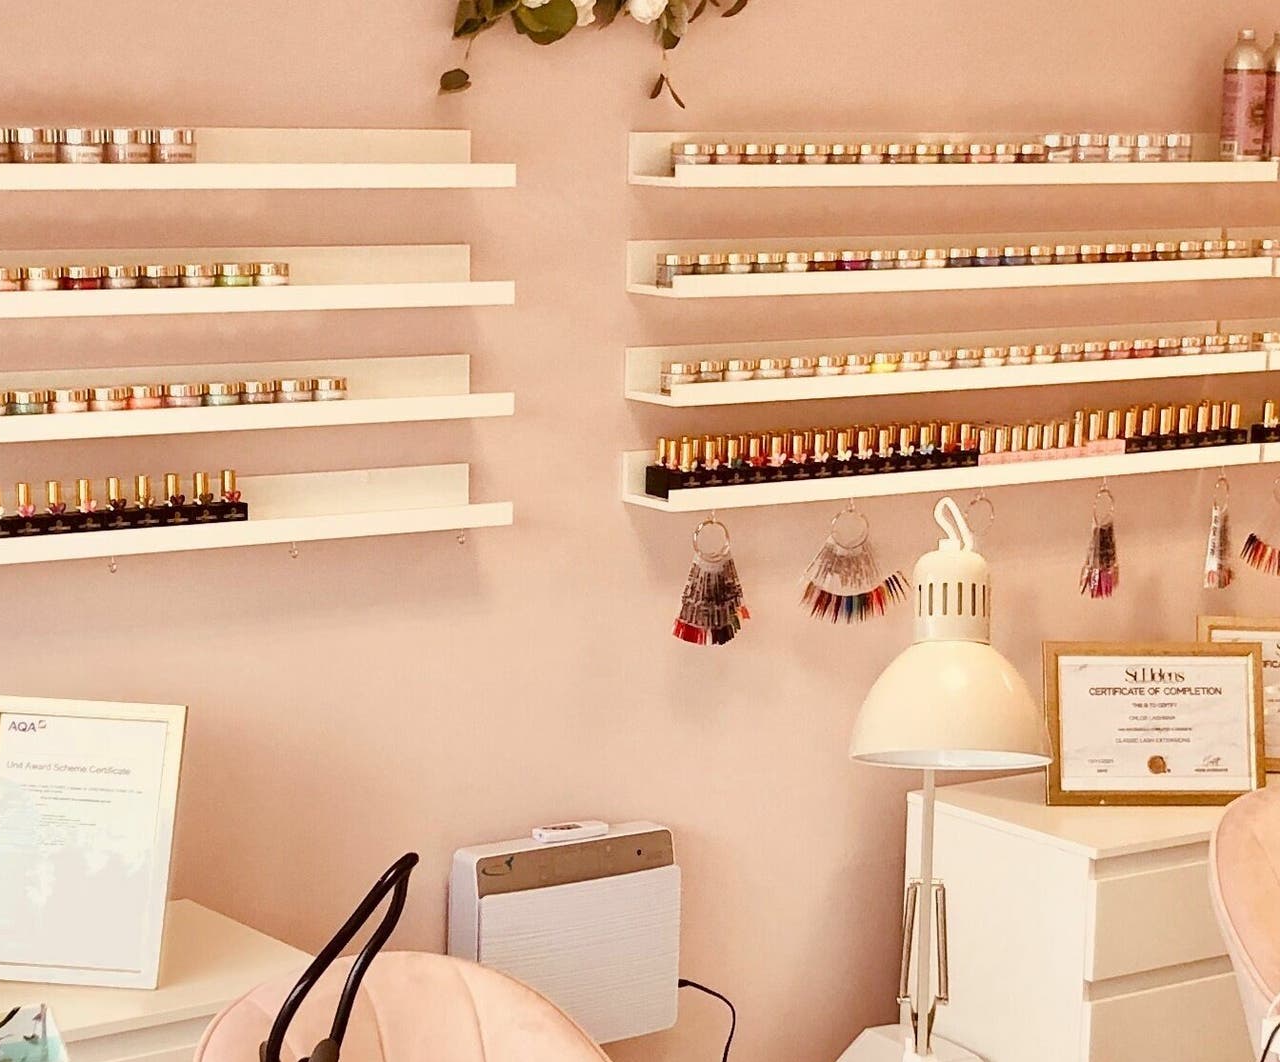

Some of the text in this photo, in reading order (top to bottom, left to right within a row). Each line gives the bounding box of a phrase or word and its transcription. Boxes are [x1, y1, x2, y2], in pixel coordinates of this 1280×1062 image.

[1088, 687, 1223, 697] CERTIFICATE OF COMPLETION
[8, 720, 37, 733] AQA
[53, 763, 88, 774] Scheme
